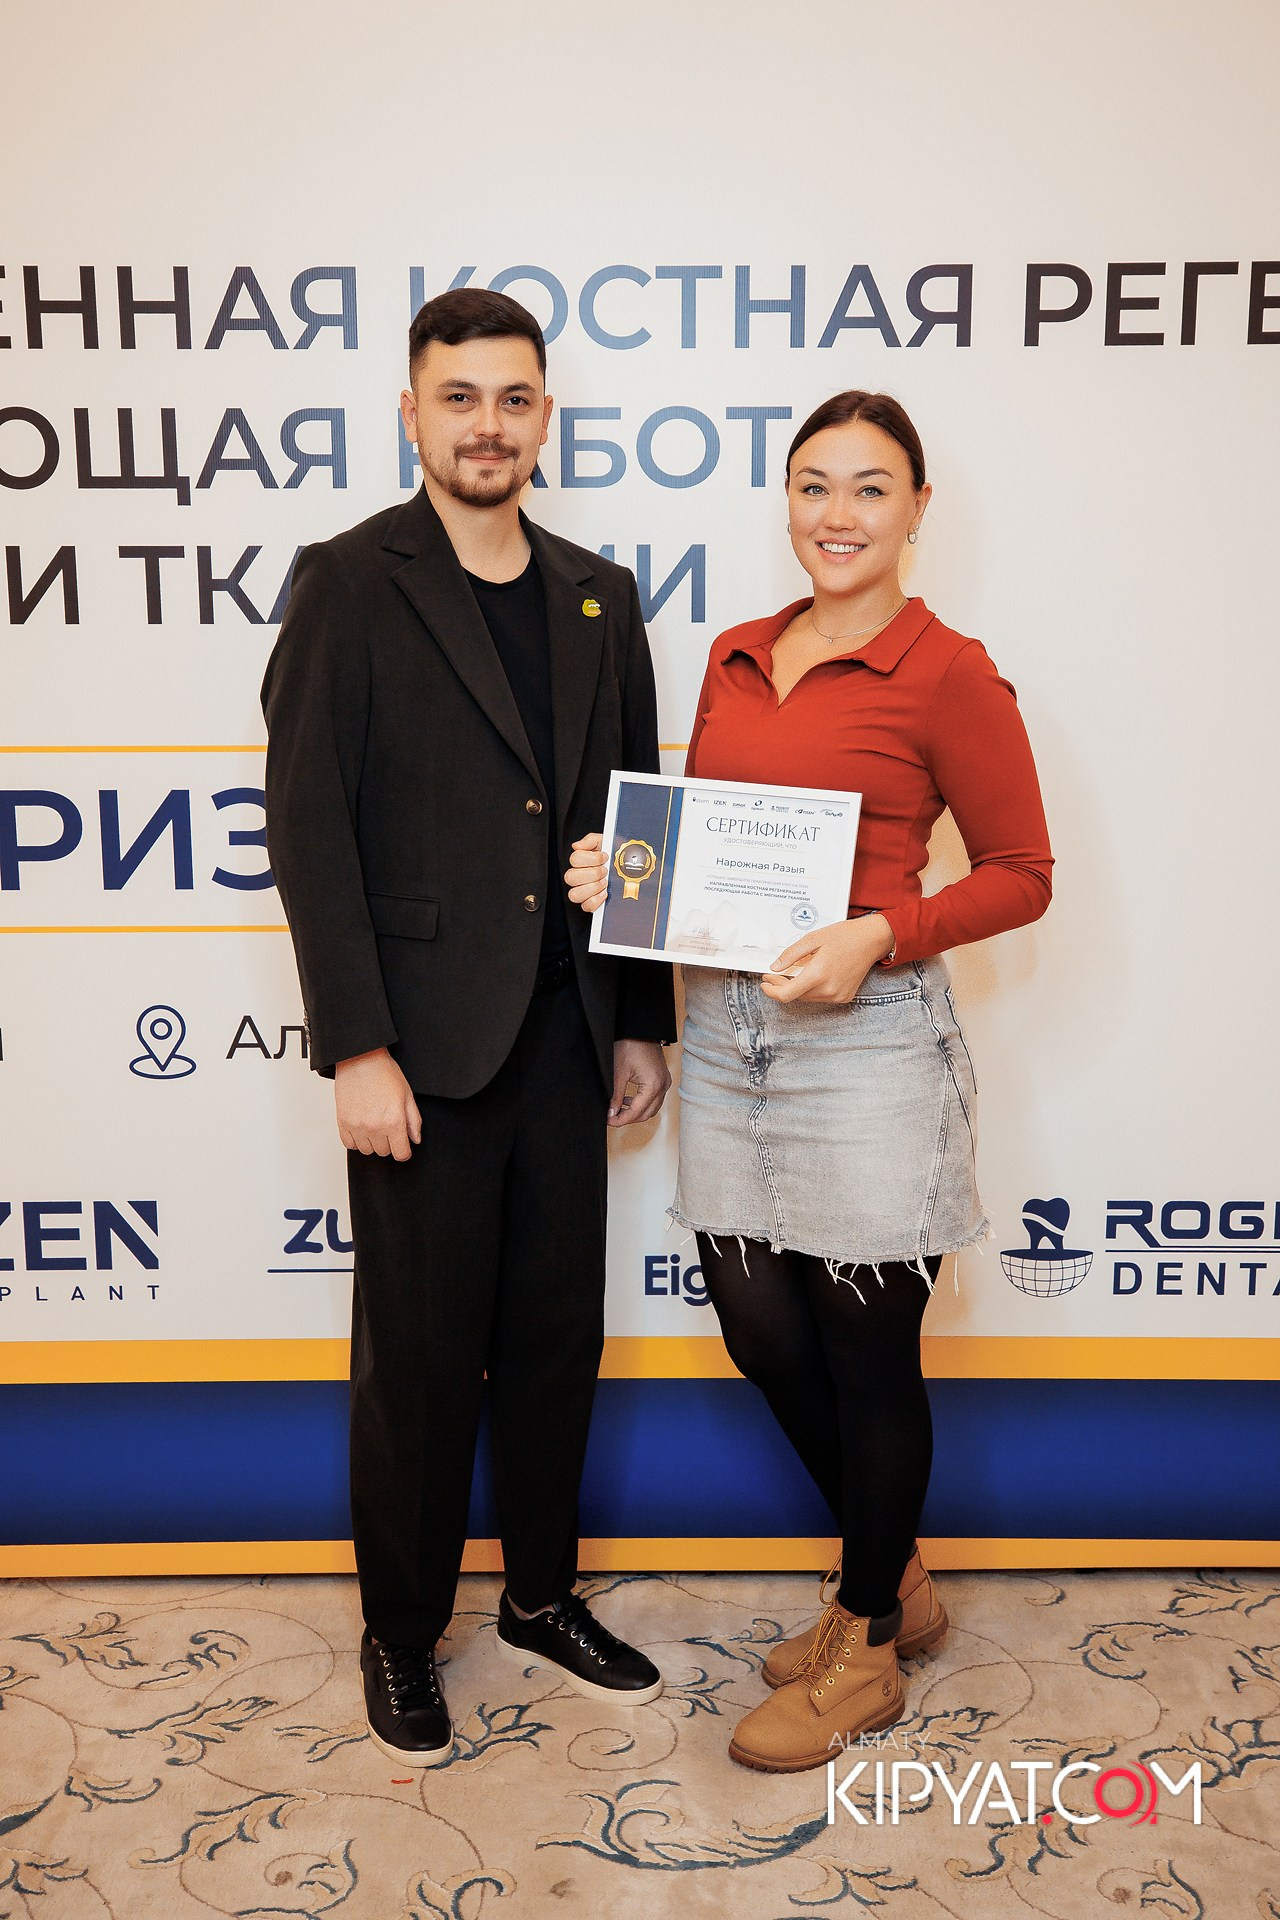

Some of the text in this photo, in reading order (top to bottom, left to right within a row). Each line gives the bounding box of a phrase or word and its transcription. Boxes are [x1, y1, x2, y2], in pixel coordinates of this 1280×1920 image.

[0, 265, 358, 350] ННАЯ
[1024, 260, 1280, 347] РЕГЕ
[398, 405, 792, 489] БОТ
[706, 816, 821, 842] СЕРТИФИКАТ
[716, 857, 806, 875] Нарожная Разыя
[226, 1015, 309, 1060] Ал
[0, 1200, 160, 1271] EN
[645, 1253, 712, 1306] Eig
